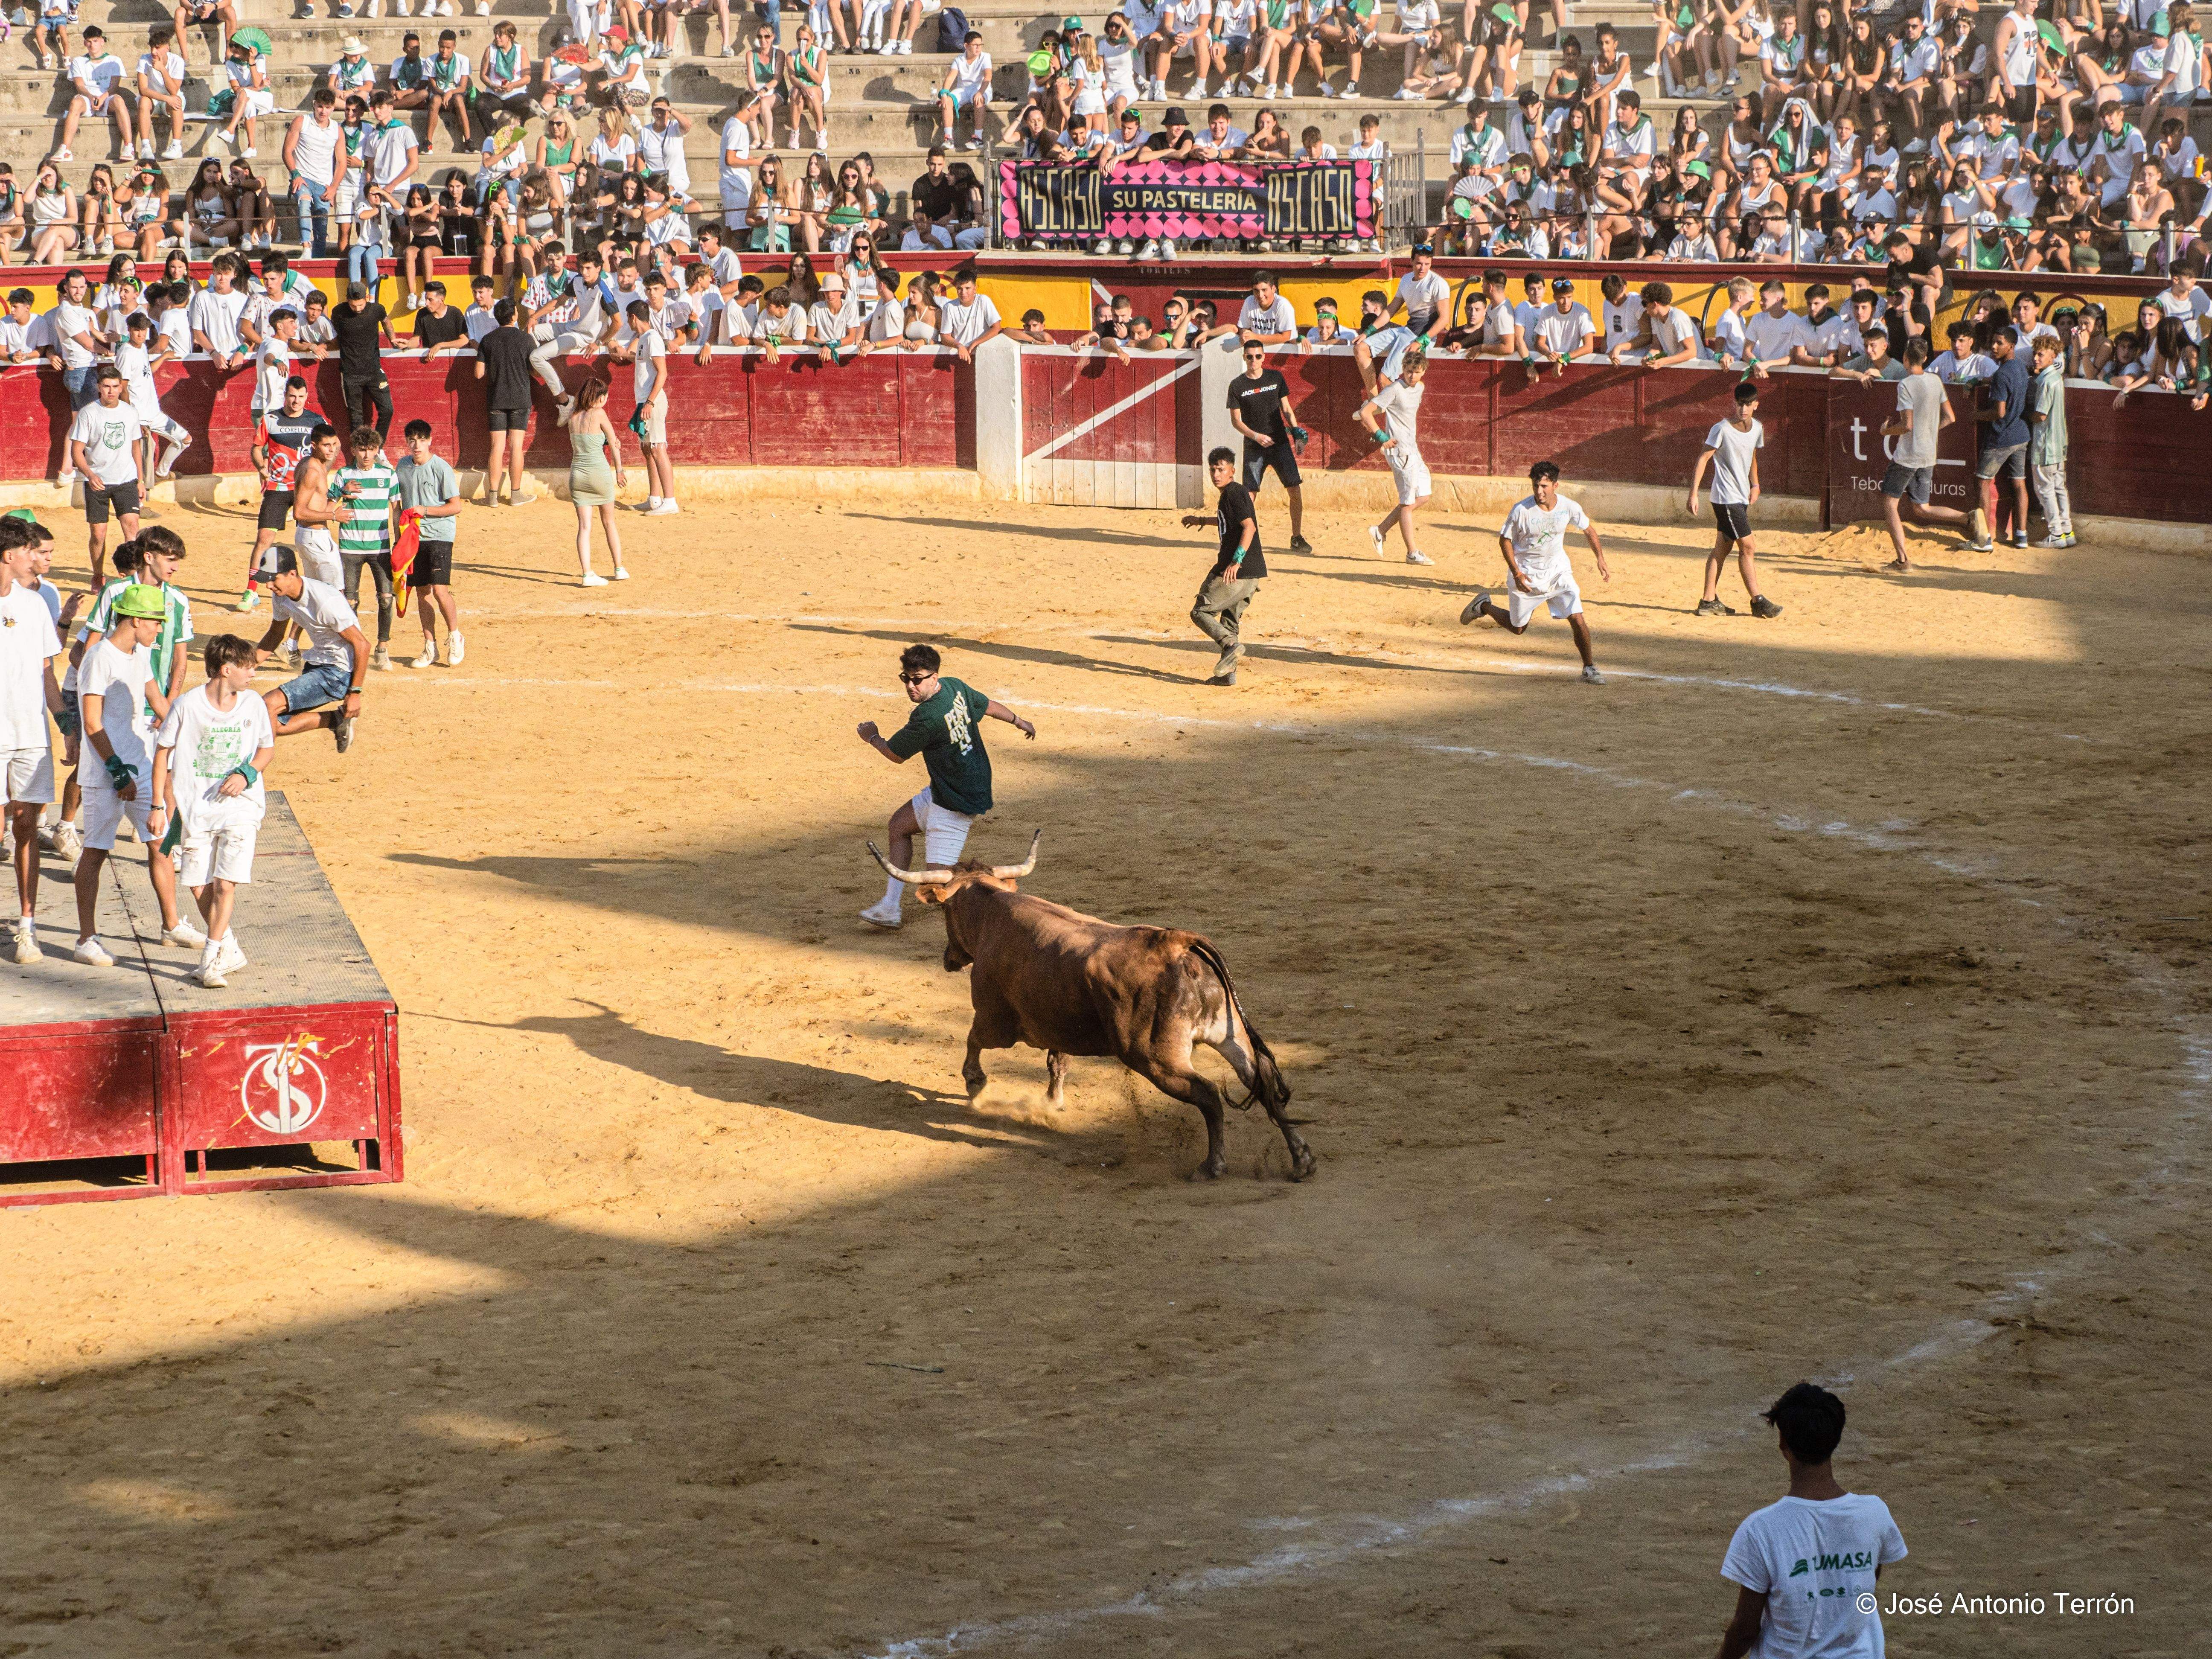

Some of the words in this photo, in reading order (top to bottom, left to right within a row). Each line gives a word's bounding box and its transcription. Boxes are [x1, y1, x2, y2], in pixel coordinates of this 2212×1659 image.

[1020, 169, 1101, 230] ASCASO
[1113, 191, 1137, 208] SU
[1142, 190, 1257, 210] PASTELERÍA
[1268, 169, 1353, 232] ASCASO
